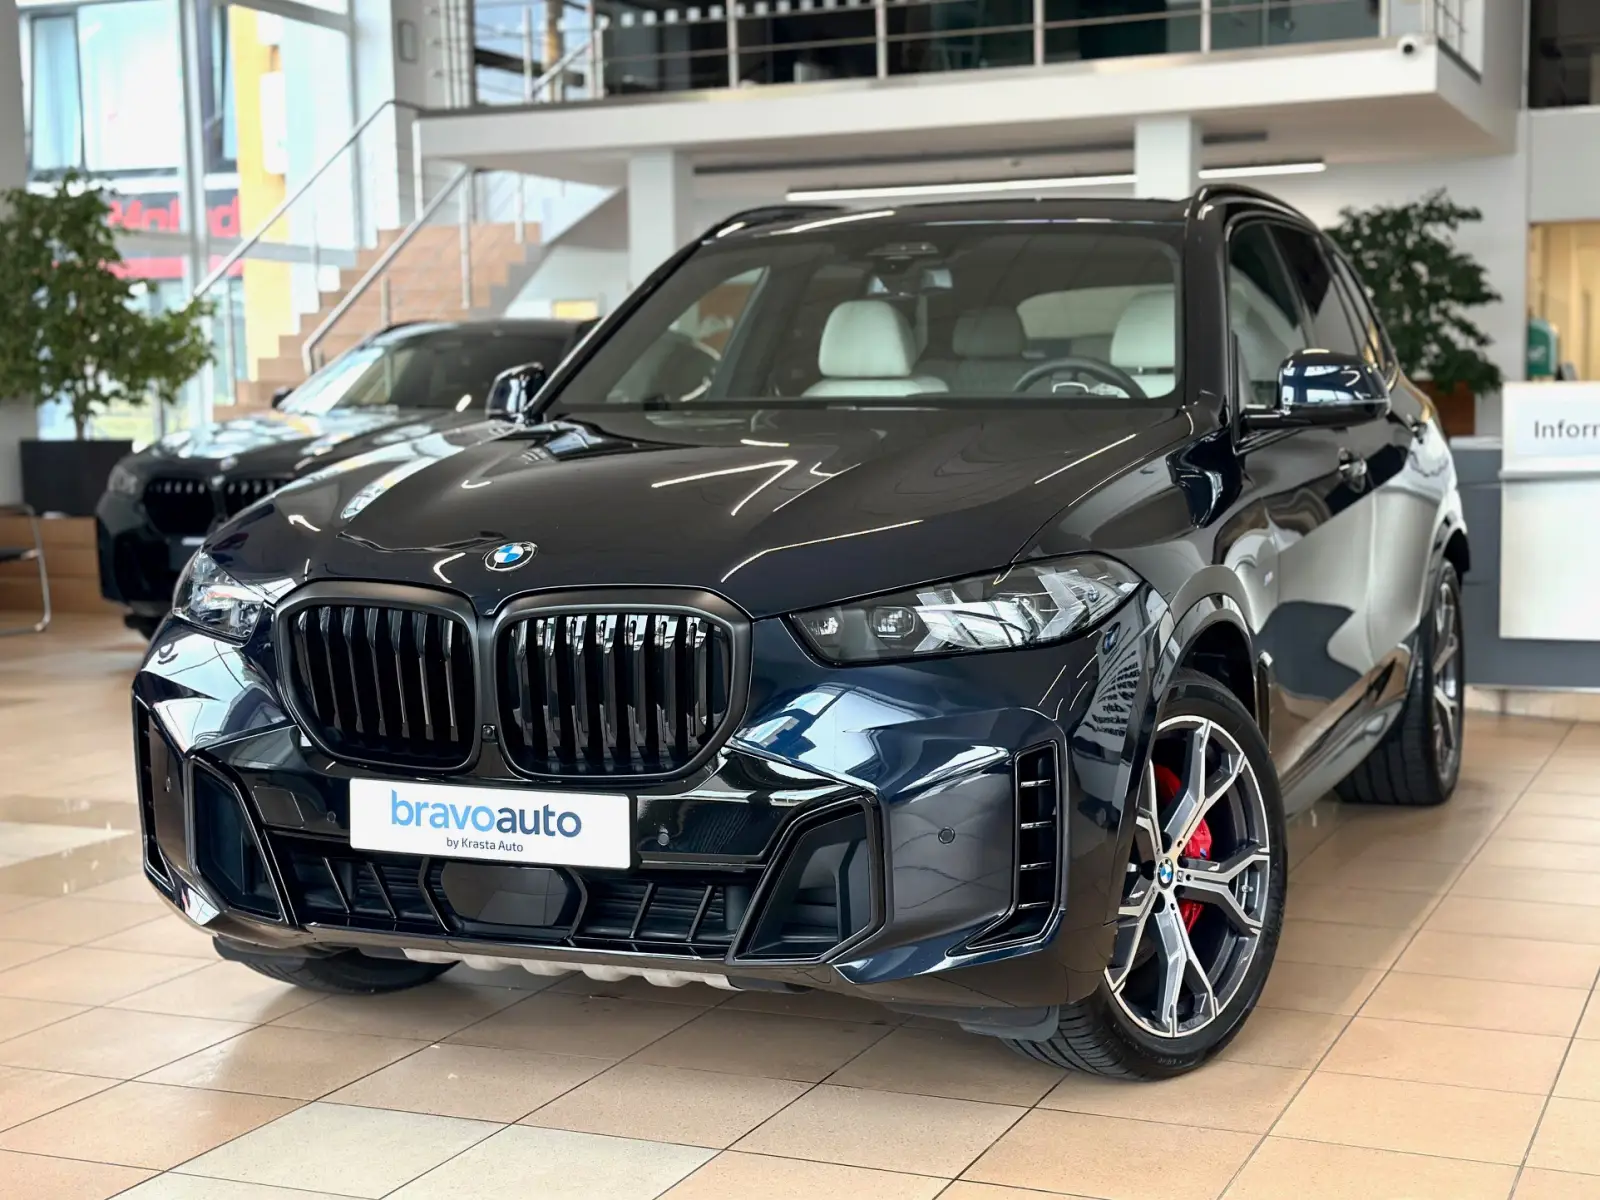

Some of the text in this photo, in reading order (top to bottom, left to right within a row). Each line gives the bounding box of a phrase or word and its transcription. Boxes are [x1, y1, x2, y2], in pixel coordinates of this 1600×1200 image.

[391, 789, 582, 837] bravoauto
[446, 837, 524, 852] by Krasta Auto
